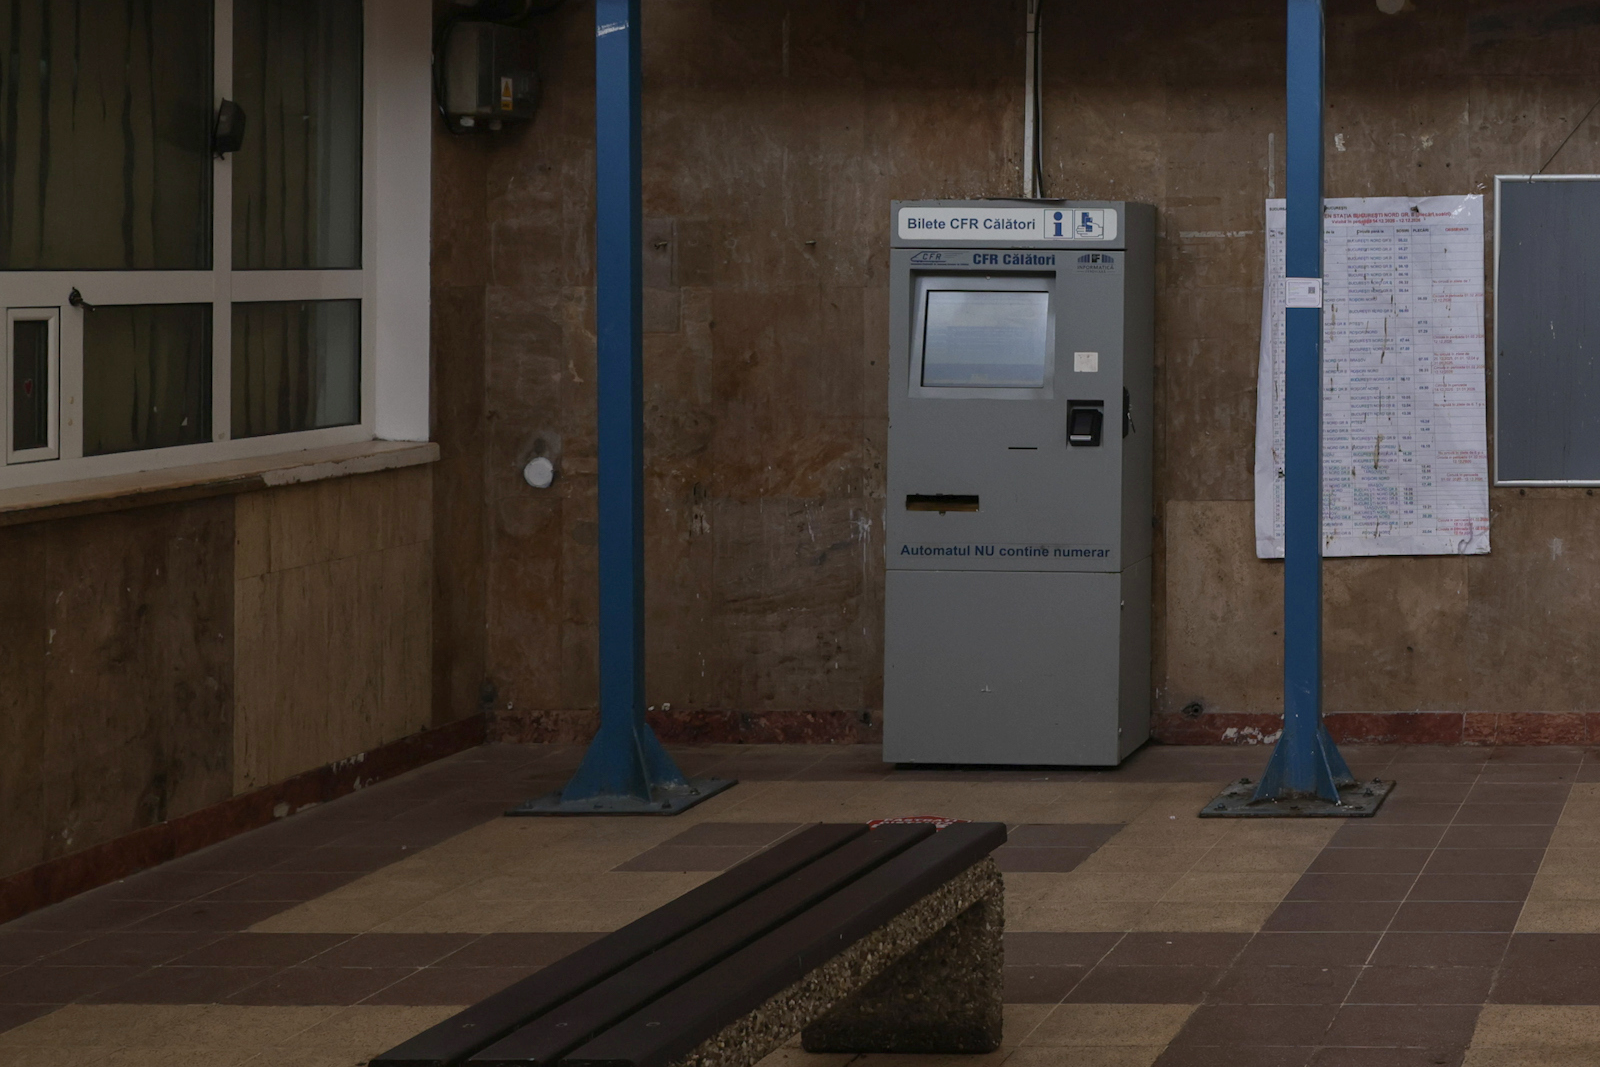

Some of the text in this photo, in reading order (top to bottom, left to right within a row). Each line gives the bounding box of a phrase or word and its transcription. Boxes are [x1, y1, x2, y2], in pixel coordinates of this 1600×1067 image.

[907, 218, 1036, 231] Bilete CFR Călători
[922, 253, 942, 261] CFR
[973, 253, 1056, 266] CFR Călători
[900, 544, 970, 557] Automatul
[975, 545, 995, 557] NU
[1054, 547, 1110, 557] numerar
